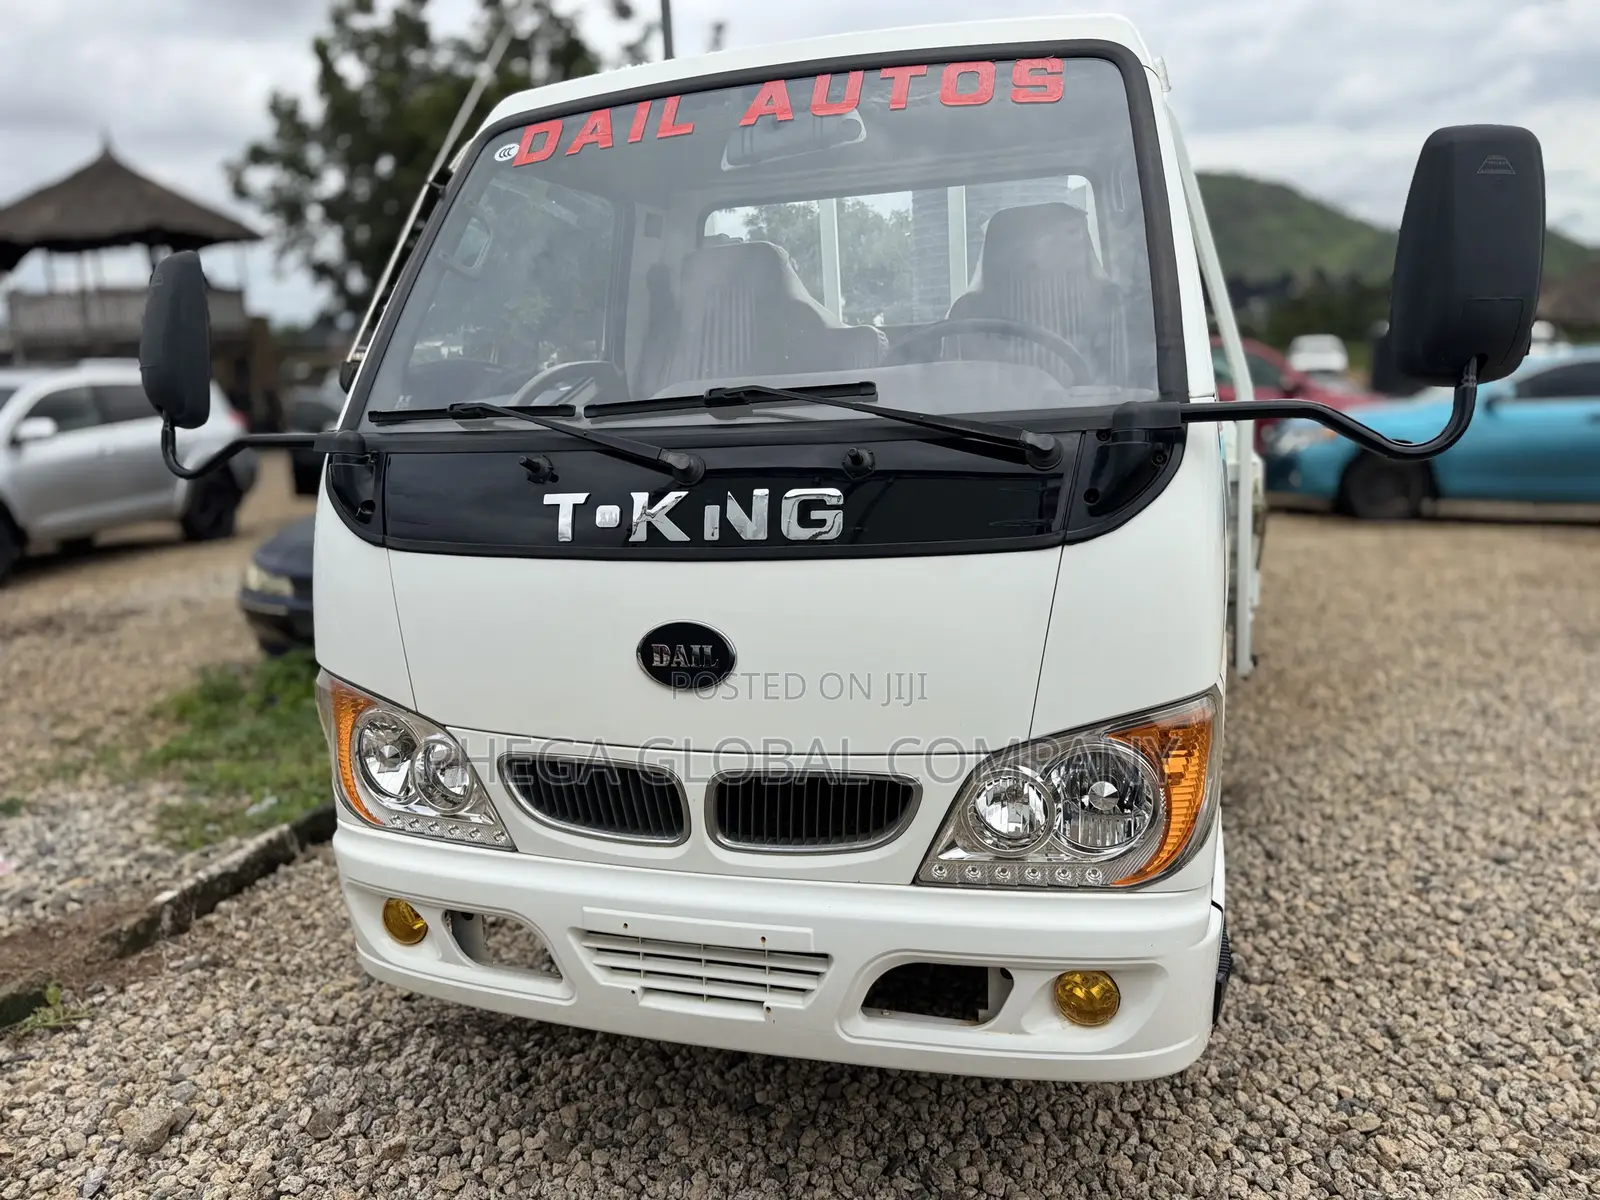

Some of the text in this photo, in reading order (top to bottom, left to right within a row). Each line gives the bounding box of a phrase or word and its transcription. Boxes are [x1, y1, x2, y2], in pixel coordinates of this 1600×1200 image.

[512, 57, 1065, 168] DAIL AUTOS
[651, 643, 719, 669] DAIL
